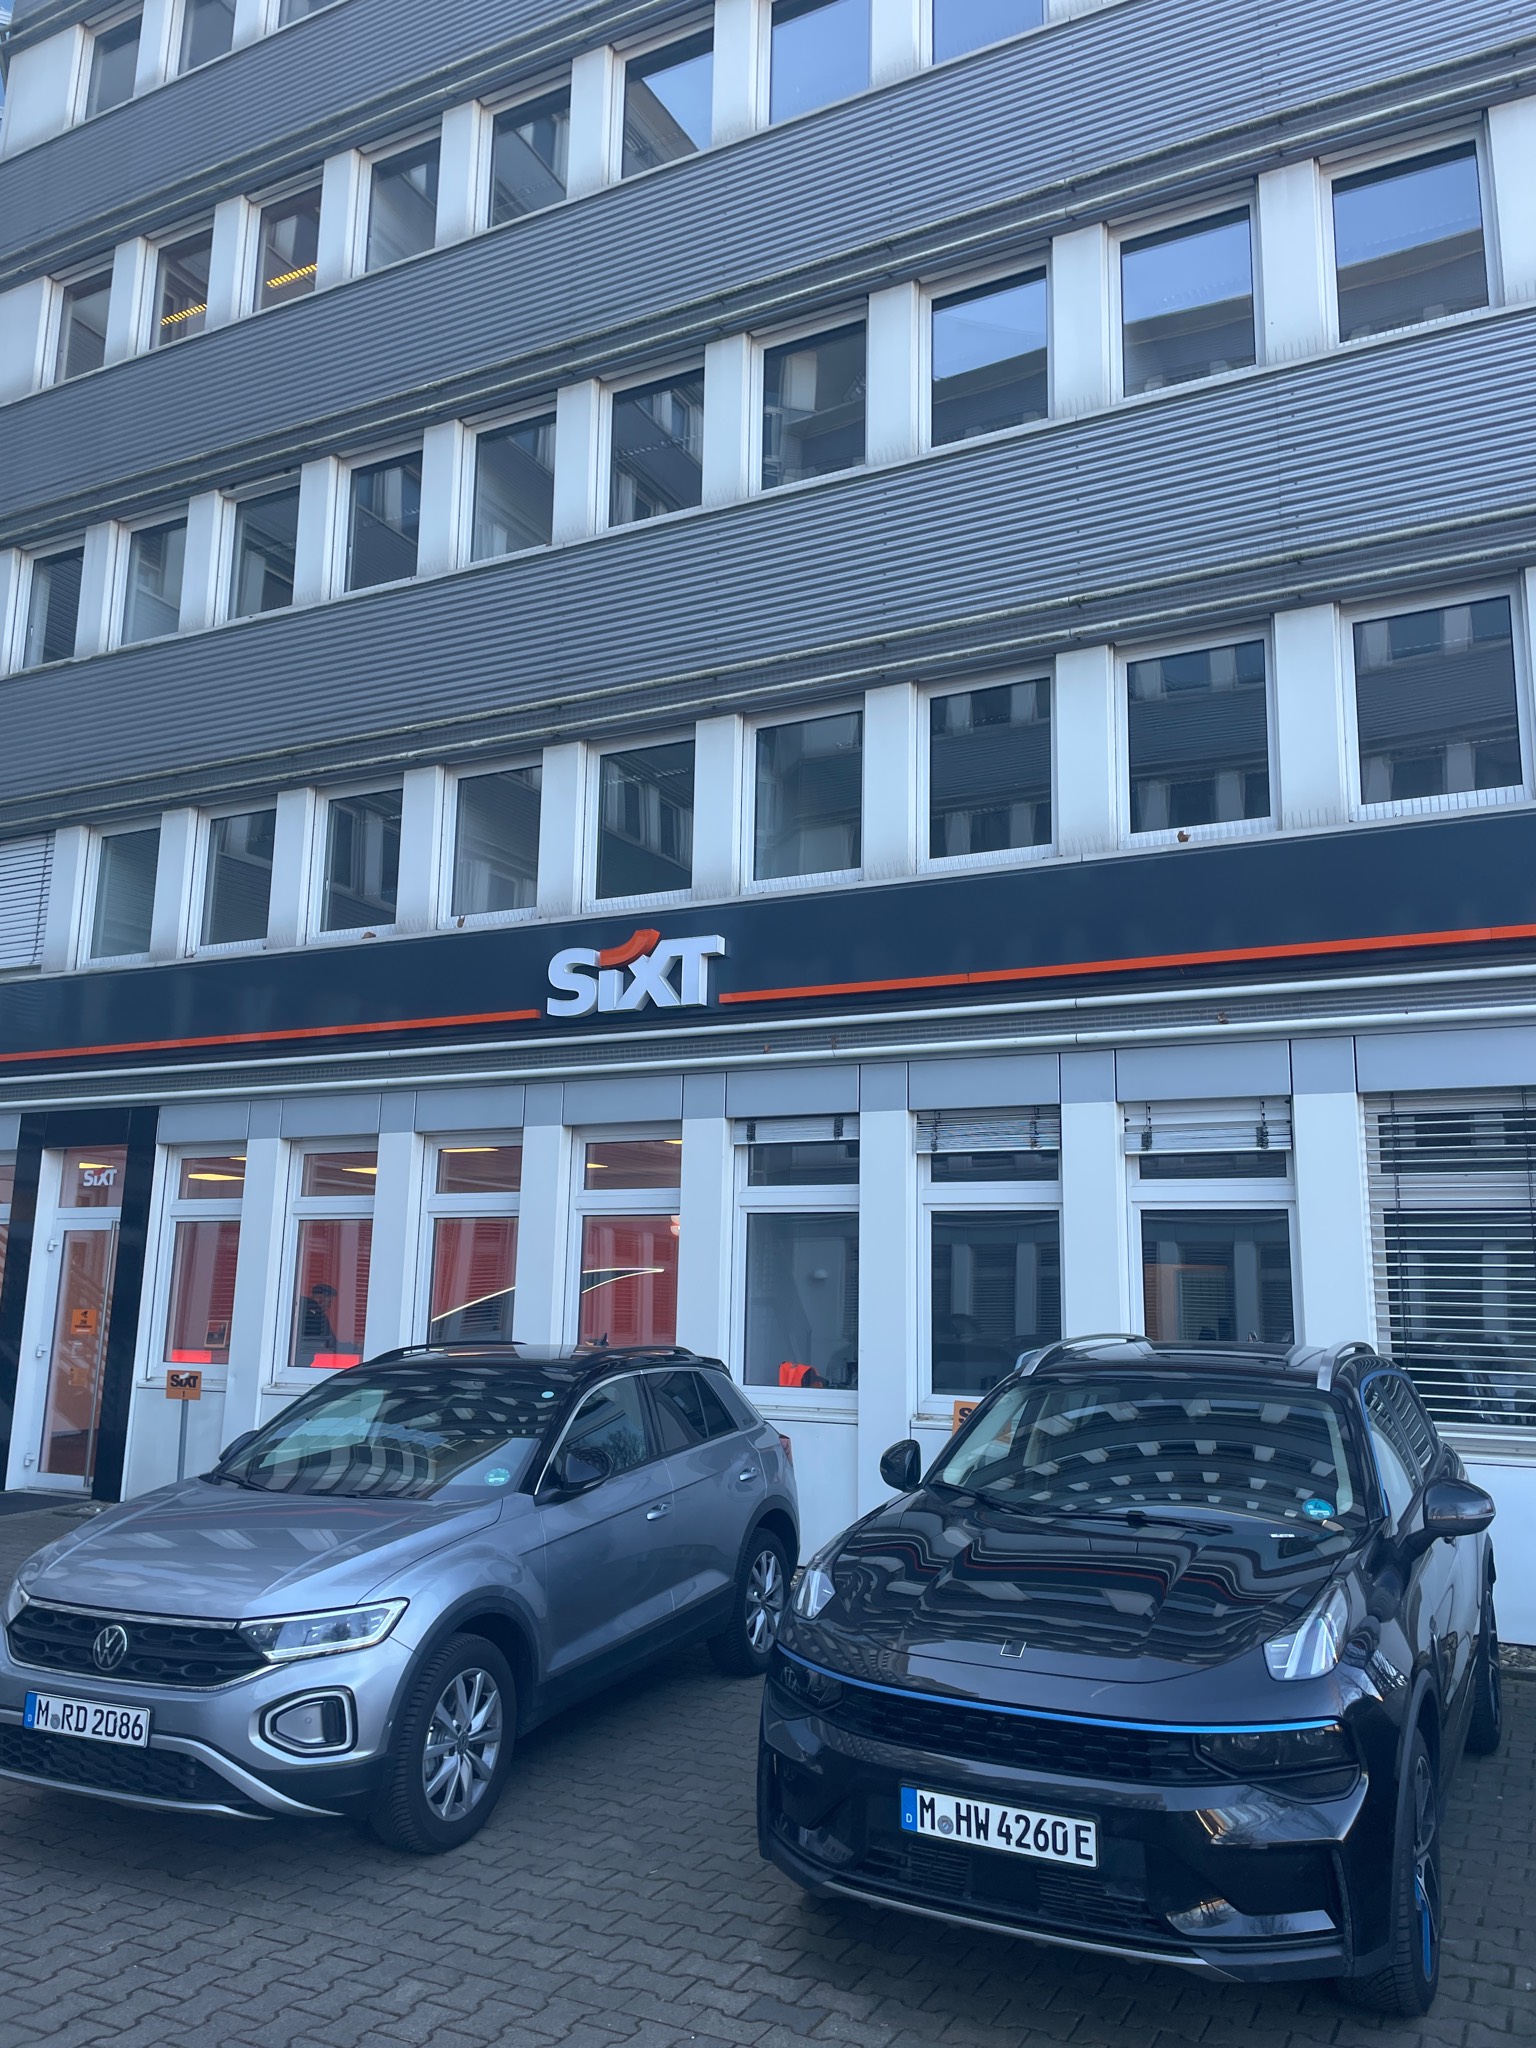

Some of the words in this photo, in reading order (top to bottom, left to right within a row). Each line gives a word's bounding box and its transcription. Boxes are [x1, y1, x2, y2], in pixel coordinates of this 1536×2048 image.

[91, 1708, 144, 1741] 2086
[905, 1813, 913, 1823] D
[955, 1802, 990, 1841] HW
